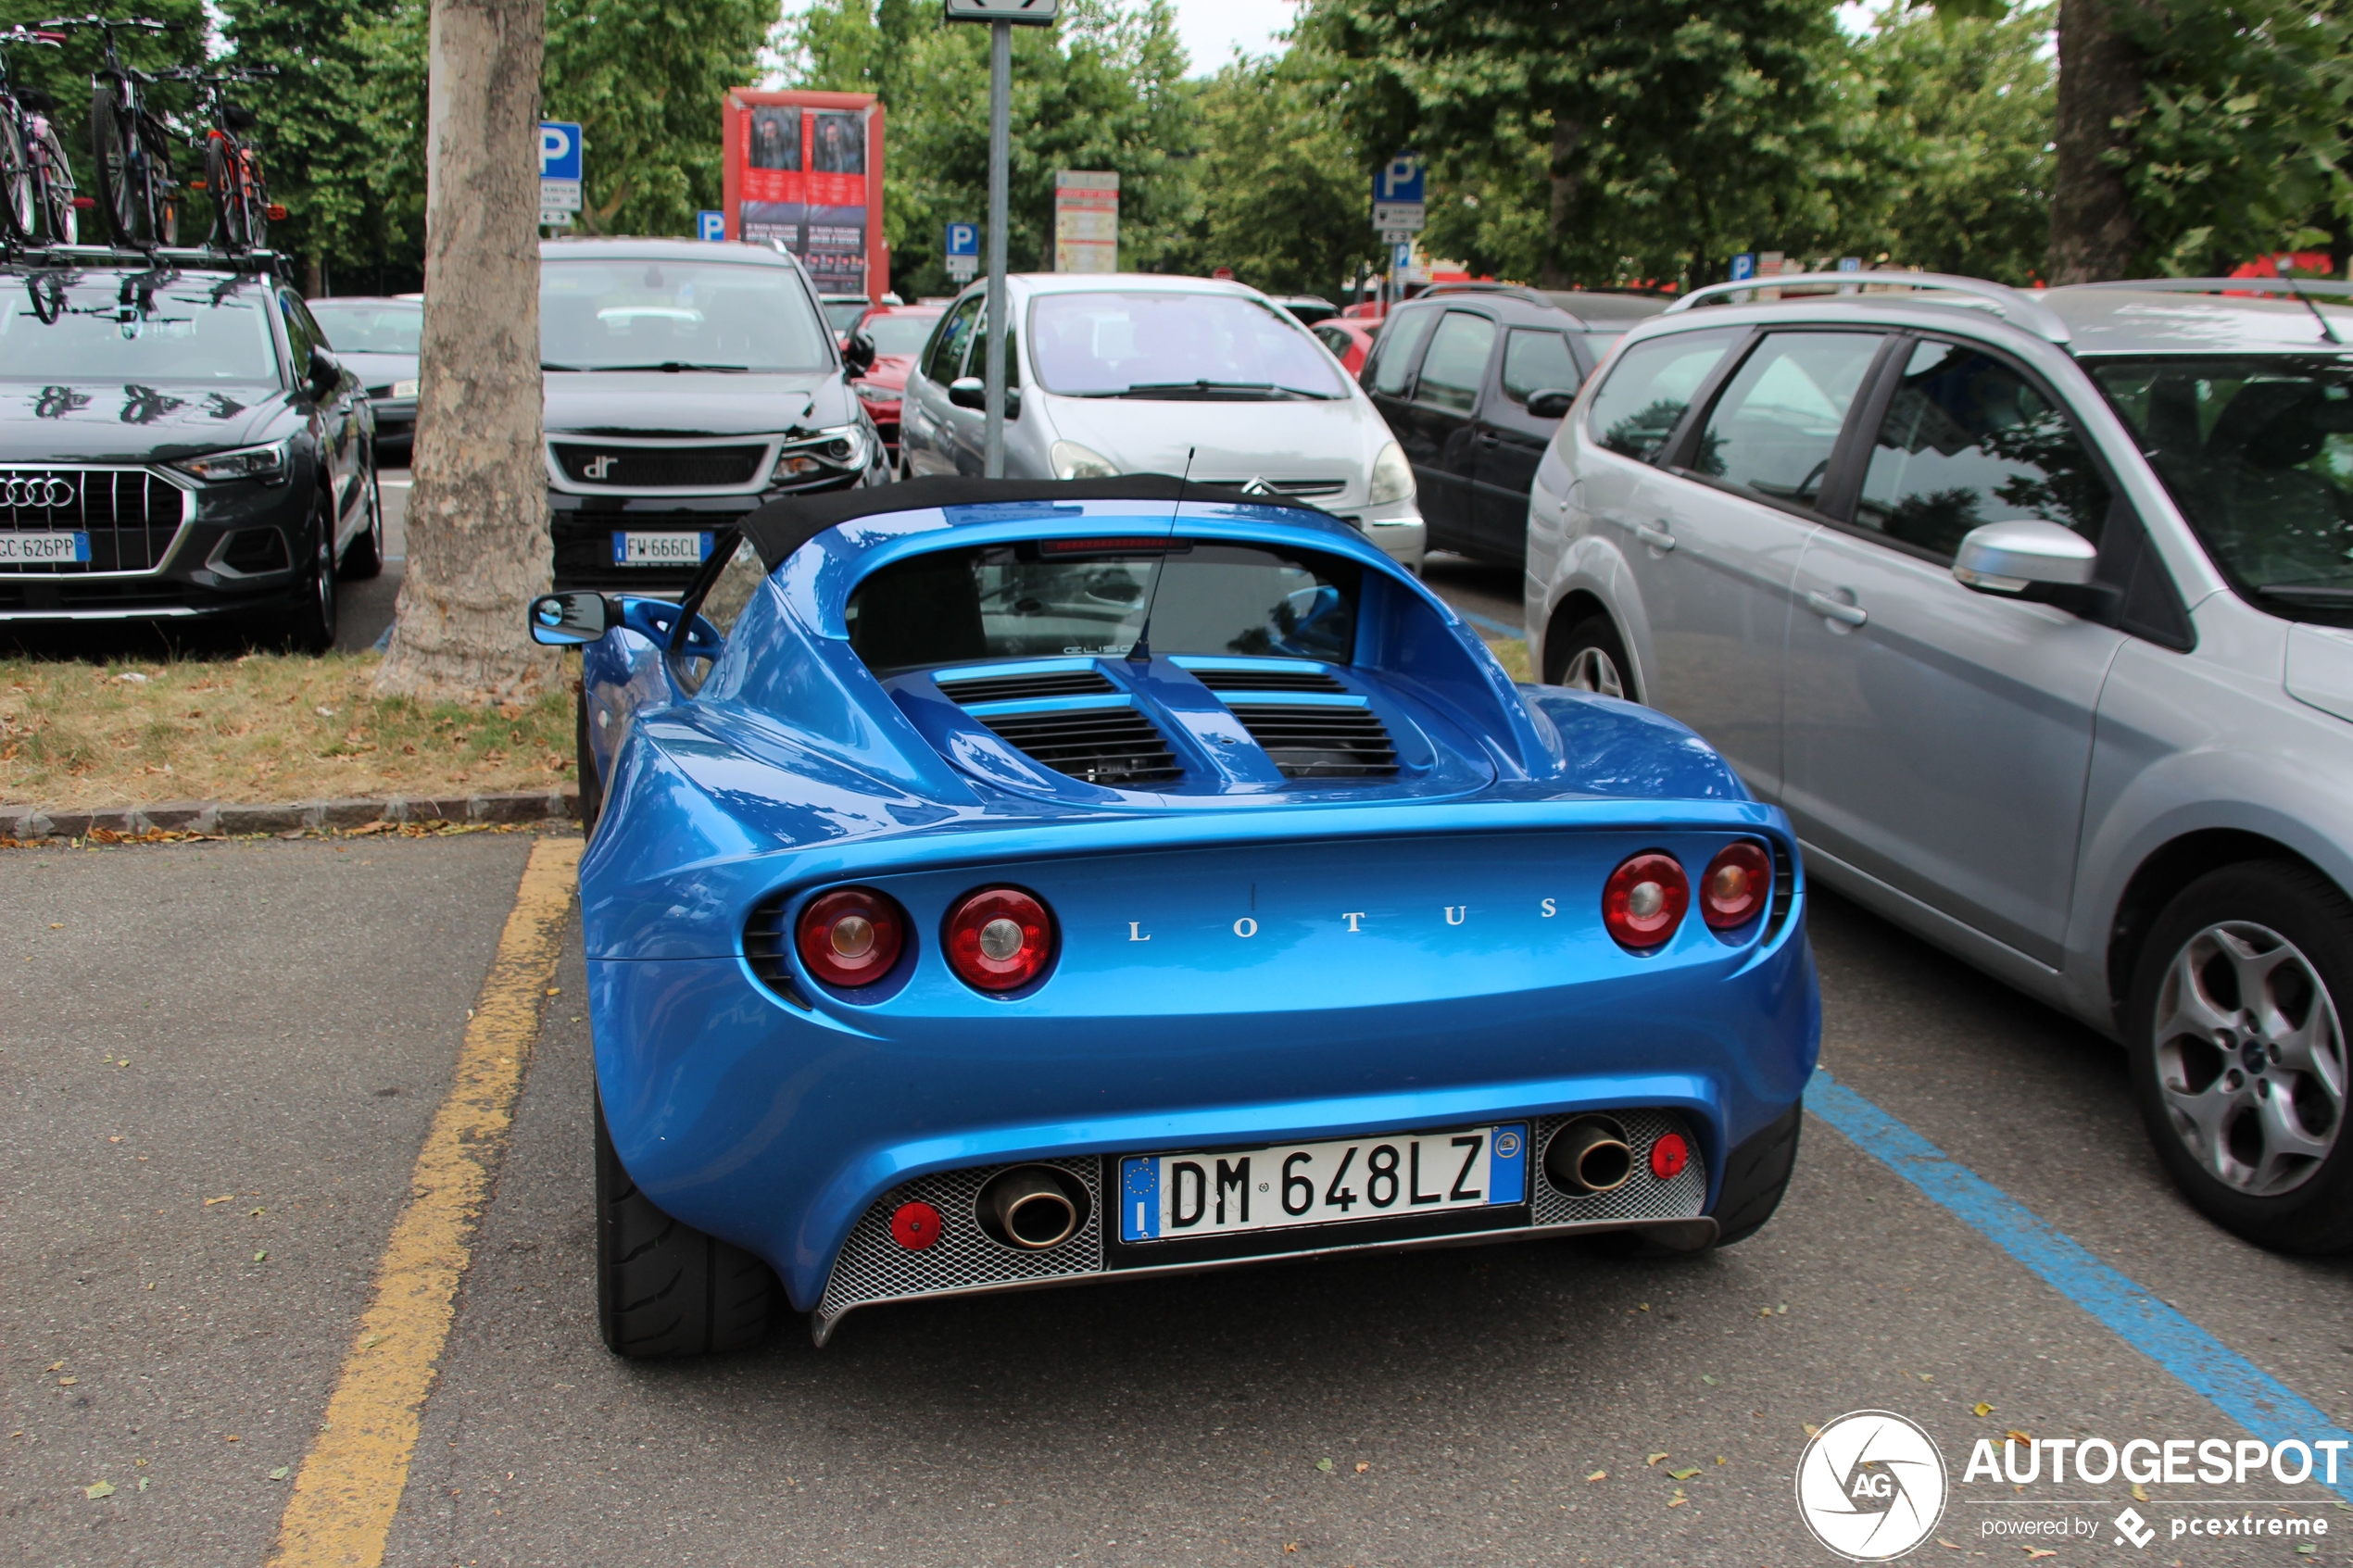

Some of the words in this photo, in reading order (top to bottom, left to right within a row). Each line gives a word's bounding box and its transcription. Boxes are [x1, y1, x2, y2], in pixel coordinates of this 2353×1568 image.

[539, 127, 571, 174] P
[1384, 155, 1416, 197] P
[704, 214, 725, 242] P
[952, 225, 974, 253] P
[1735, 256, 1751, 281] P
[23, 538, 74, 558] 626PP
[627, 537, 647, 557] FW
[650, 537, 699, 558] 666CL
[1171, 1156, 1251, 1229] DM
[1280, 1135, 1484, 1217] 648LZ
